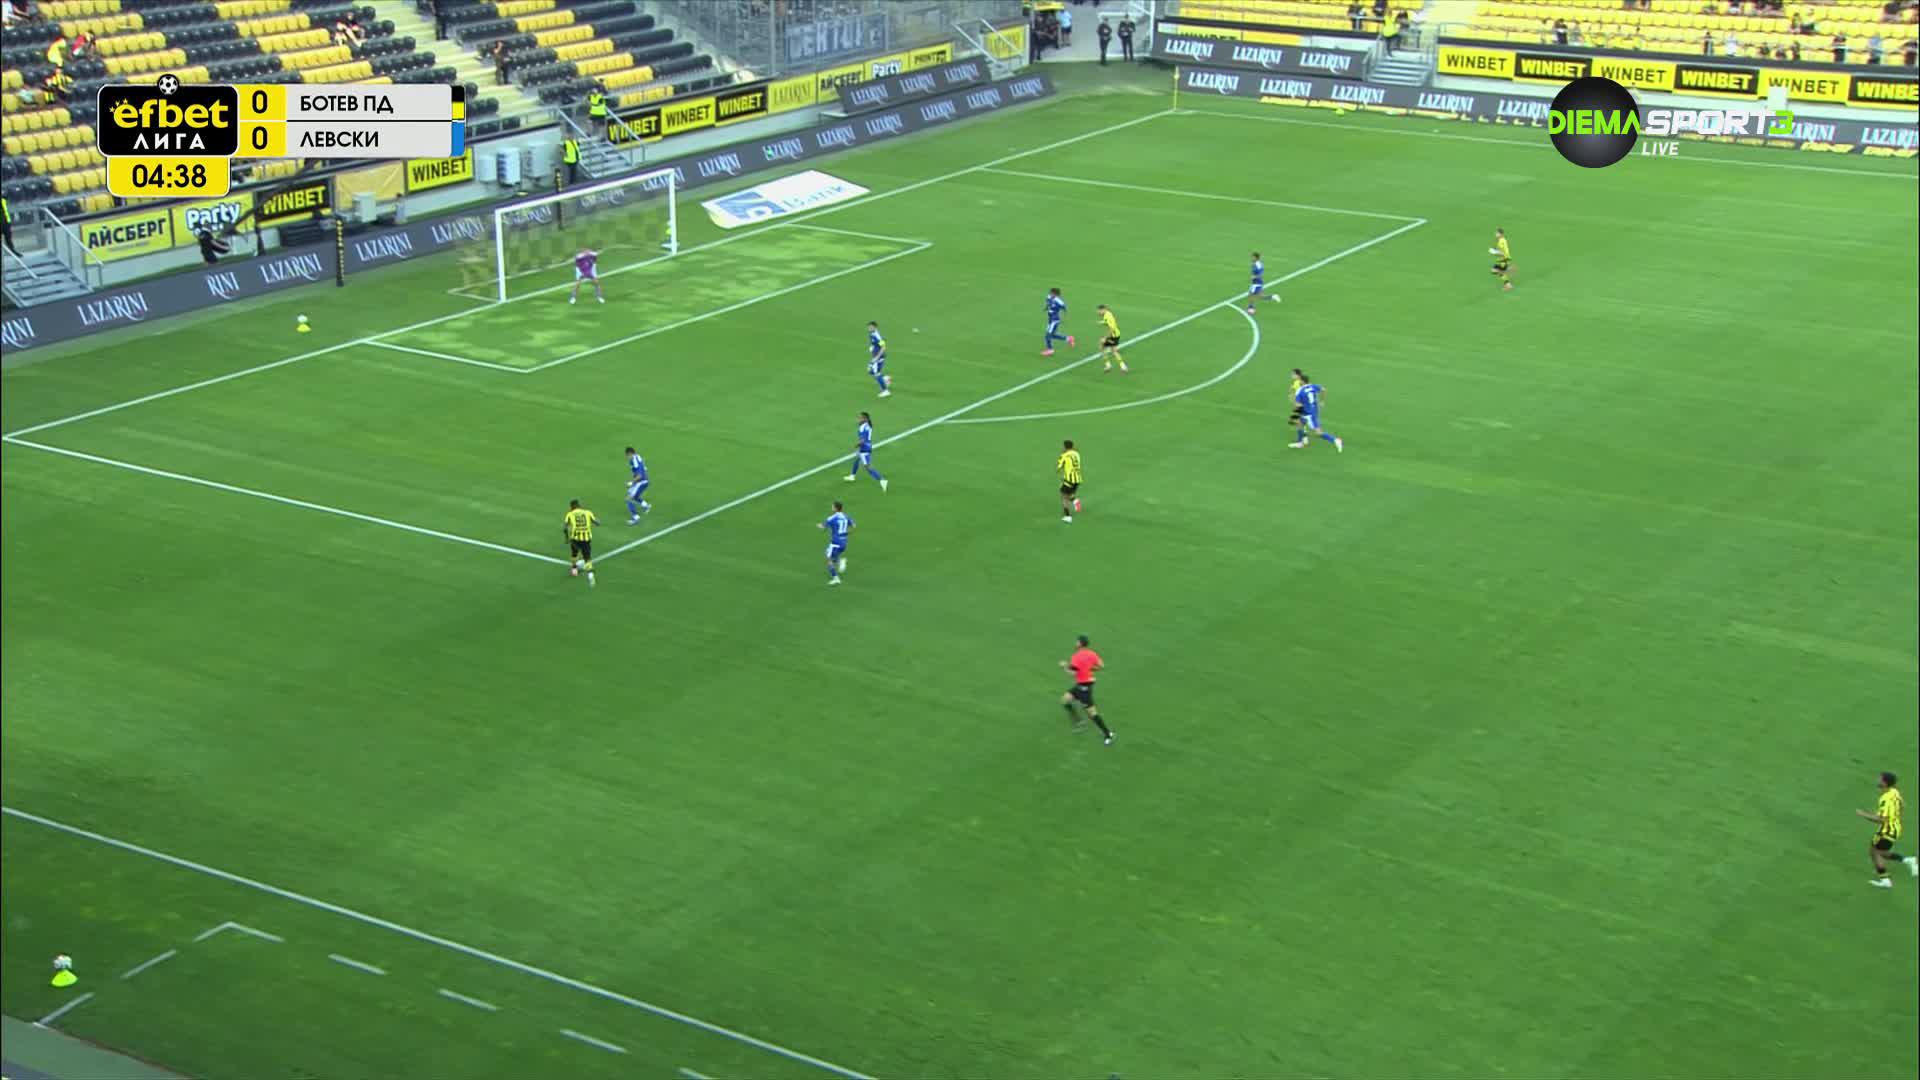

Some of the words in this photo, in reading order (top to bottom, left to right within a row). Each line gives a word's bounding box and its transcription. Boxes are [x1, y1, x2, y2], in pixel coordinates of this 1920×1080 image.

[1165, 39, 1214, 62] LAZARINI
[1232, 46, 1282, 69] LAZARINI
[1300, 52, 1351, 74] LAZARINI
[1446, 54, 1507, 72] WINBET
[1521, 58, 1587, 78] WINBET
[1600, 64, 1667, 84] WINBET
[1188, 72, 1239, 95] LAZARINI
[1260, 78, 1312, 99] LAZARINI
[1681, 70, 1753, 91] WINBET
[718, 92, 763, 117] WINBET
[1331, 85, 1386, 106] LAZARINI
[1417, 92, 1474, 115] LAZARINI
[666, 104, 712, 129] WINBET
[412, 156, 468, 183] WINBET
[263, 185, 326, 215] WINBET
[88, 218, 166, 249] АЙСБЕРГ
[355, 231, 413, 261] LAZARINI
[259, 252, 323, 285] LAZARINI
[207, 271, 241, 300] RINI
[77, 291, 149, 325] LAZARINI
